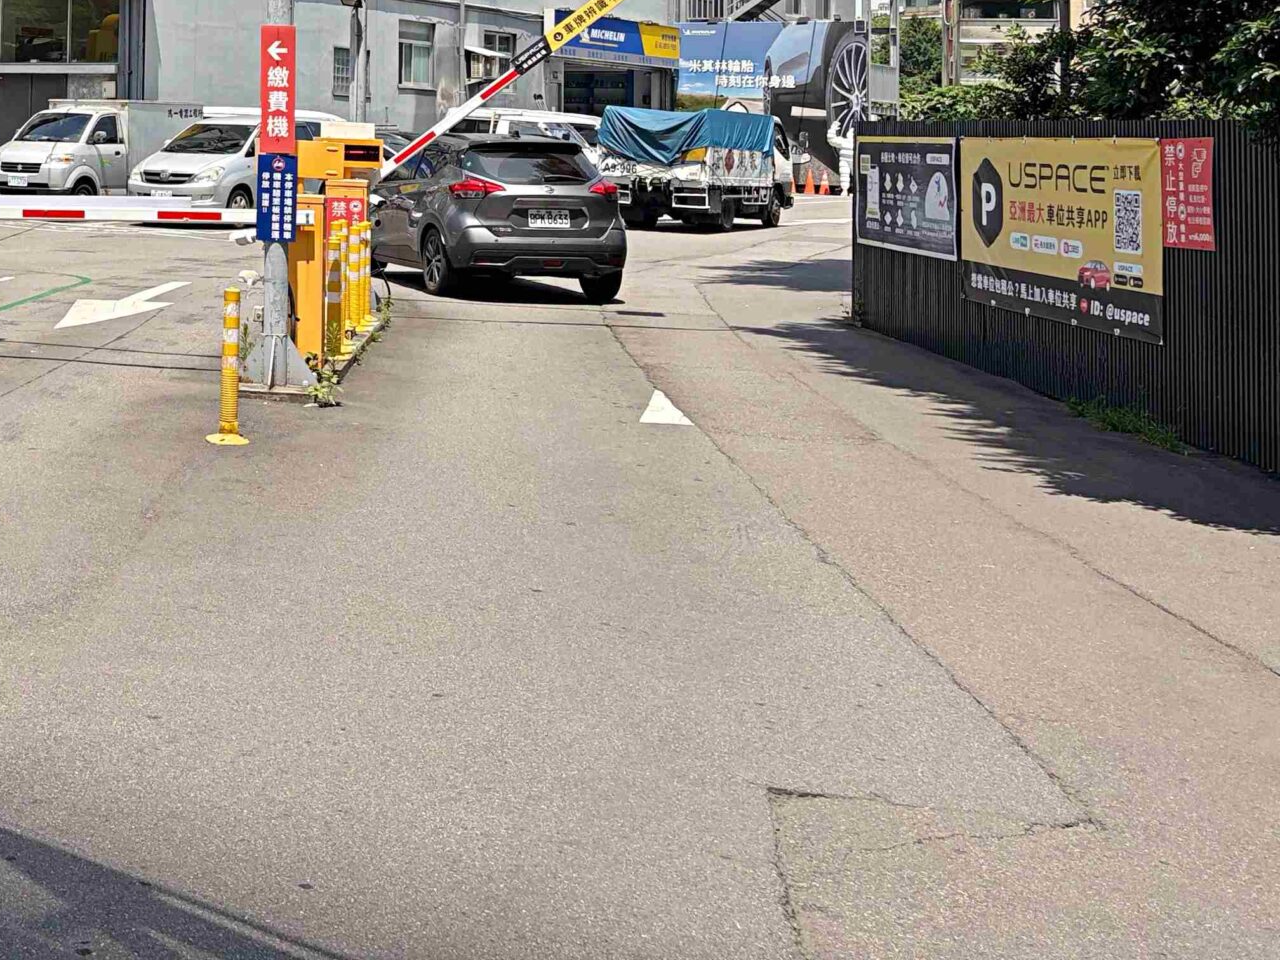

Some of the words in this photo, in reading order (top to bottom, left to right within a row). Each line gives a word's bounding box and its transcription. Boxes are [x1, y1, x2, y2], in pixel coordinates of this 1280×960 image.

[590, 28, 626, 42] MICHELIN
[689, 60, 754, 74] 米其林輪胎
[714, 75, 796, 89] 時刻在你身邊
[266, 66, 289, 138] 繳費機
[1008, 161, 1107, 194] USPACE
[1113, 165, 1142, 182] 立即下載
[1164, 144, 1178, 244] 禁止停放
[1089, 300, 1104, 317] ID:
[1105, 304, 1151, 327] @uspace
